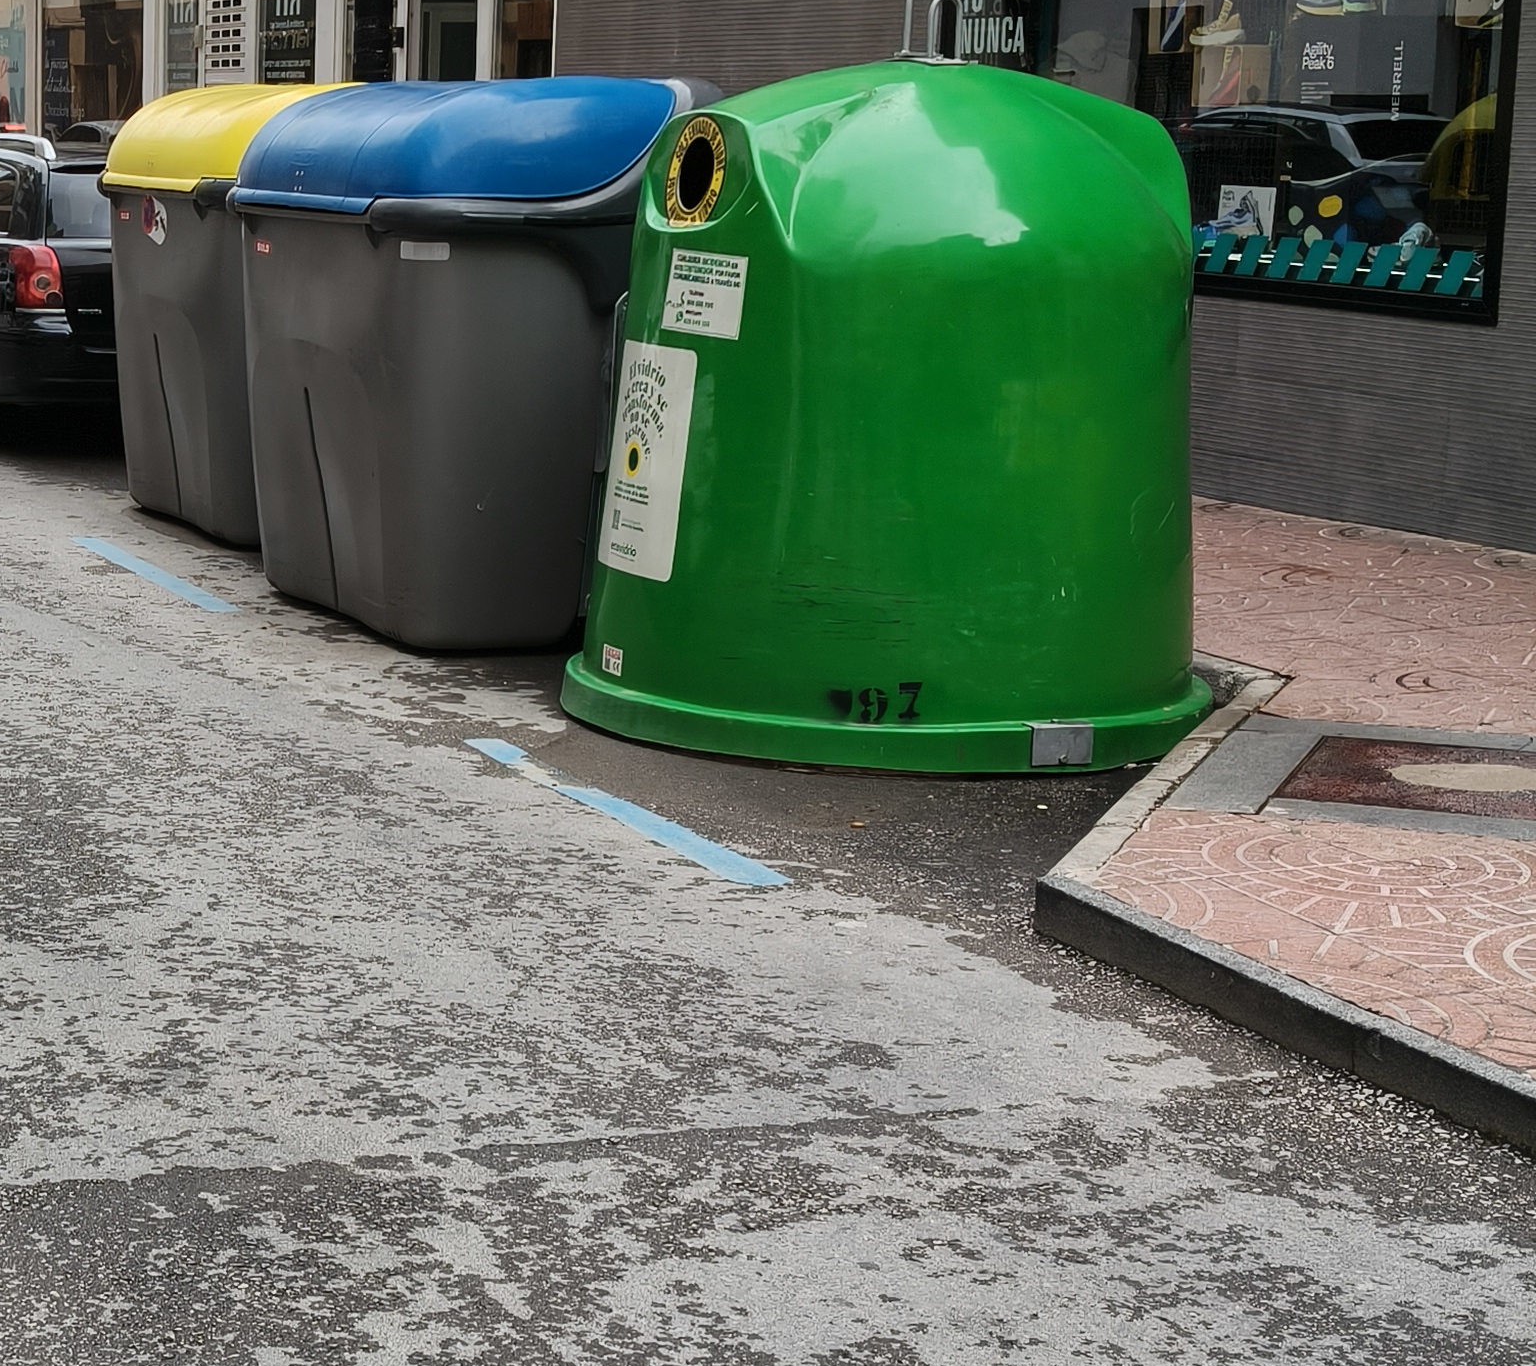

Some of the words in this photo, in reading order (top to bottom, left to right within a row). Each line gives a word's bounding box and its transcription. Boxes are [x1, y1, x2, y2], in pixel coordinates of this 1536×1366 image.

[961, 16, 1025, 54] NUNCA
[1303, 42, 1333, 59] Agility
[1302, 56, 1326, 70] Peak
[1326, 56, 1335, 70] 6
[1390, 40, 1404, 122] MERRELL
[630, 361, 637, 381] El
[638, 358, 666, 387] vidrio
[631, 381, 649, 394] crea
[657, 394, 668, 412] se
[623, 393, 664, 439] transforma.
[641, 413, 650, 428] se
[624, 424, 651, 461] destruye.
